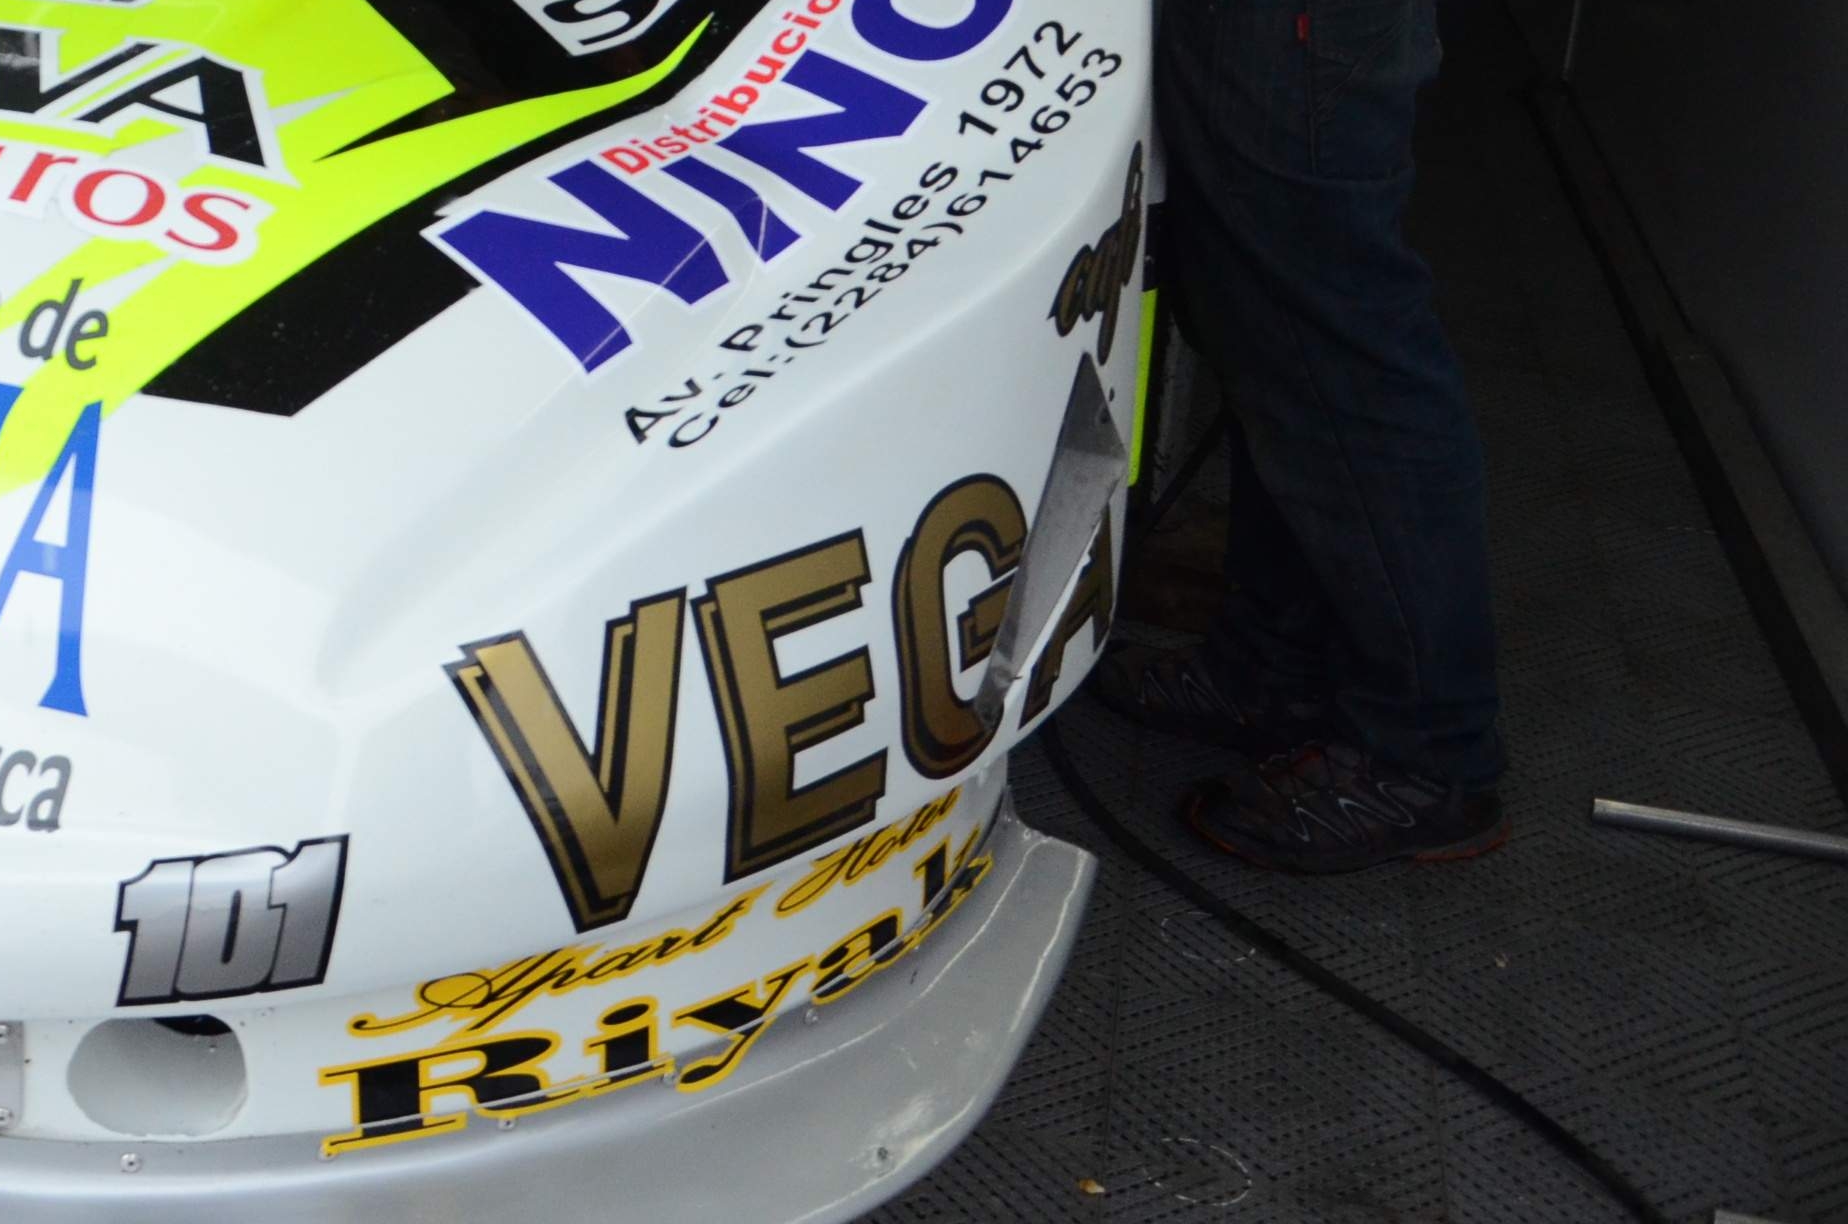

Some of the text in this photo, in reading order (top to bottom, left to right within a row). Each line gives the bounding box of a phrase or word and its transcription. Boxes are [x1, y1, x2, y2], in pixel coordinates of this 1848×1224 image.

[666, 46, 1126, 450] Cel:(2284)614653
[718, 158, 960, 353] Pringles
[958, 19, 1084, 140] 1972
[19, 277, 109, 371] de
[113, 833, 350, 1008] 101
